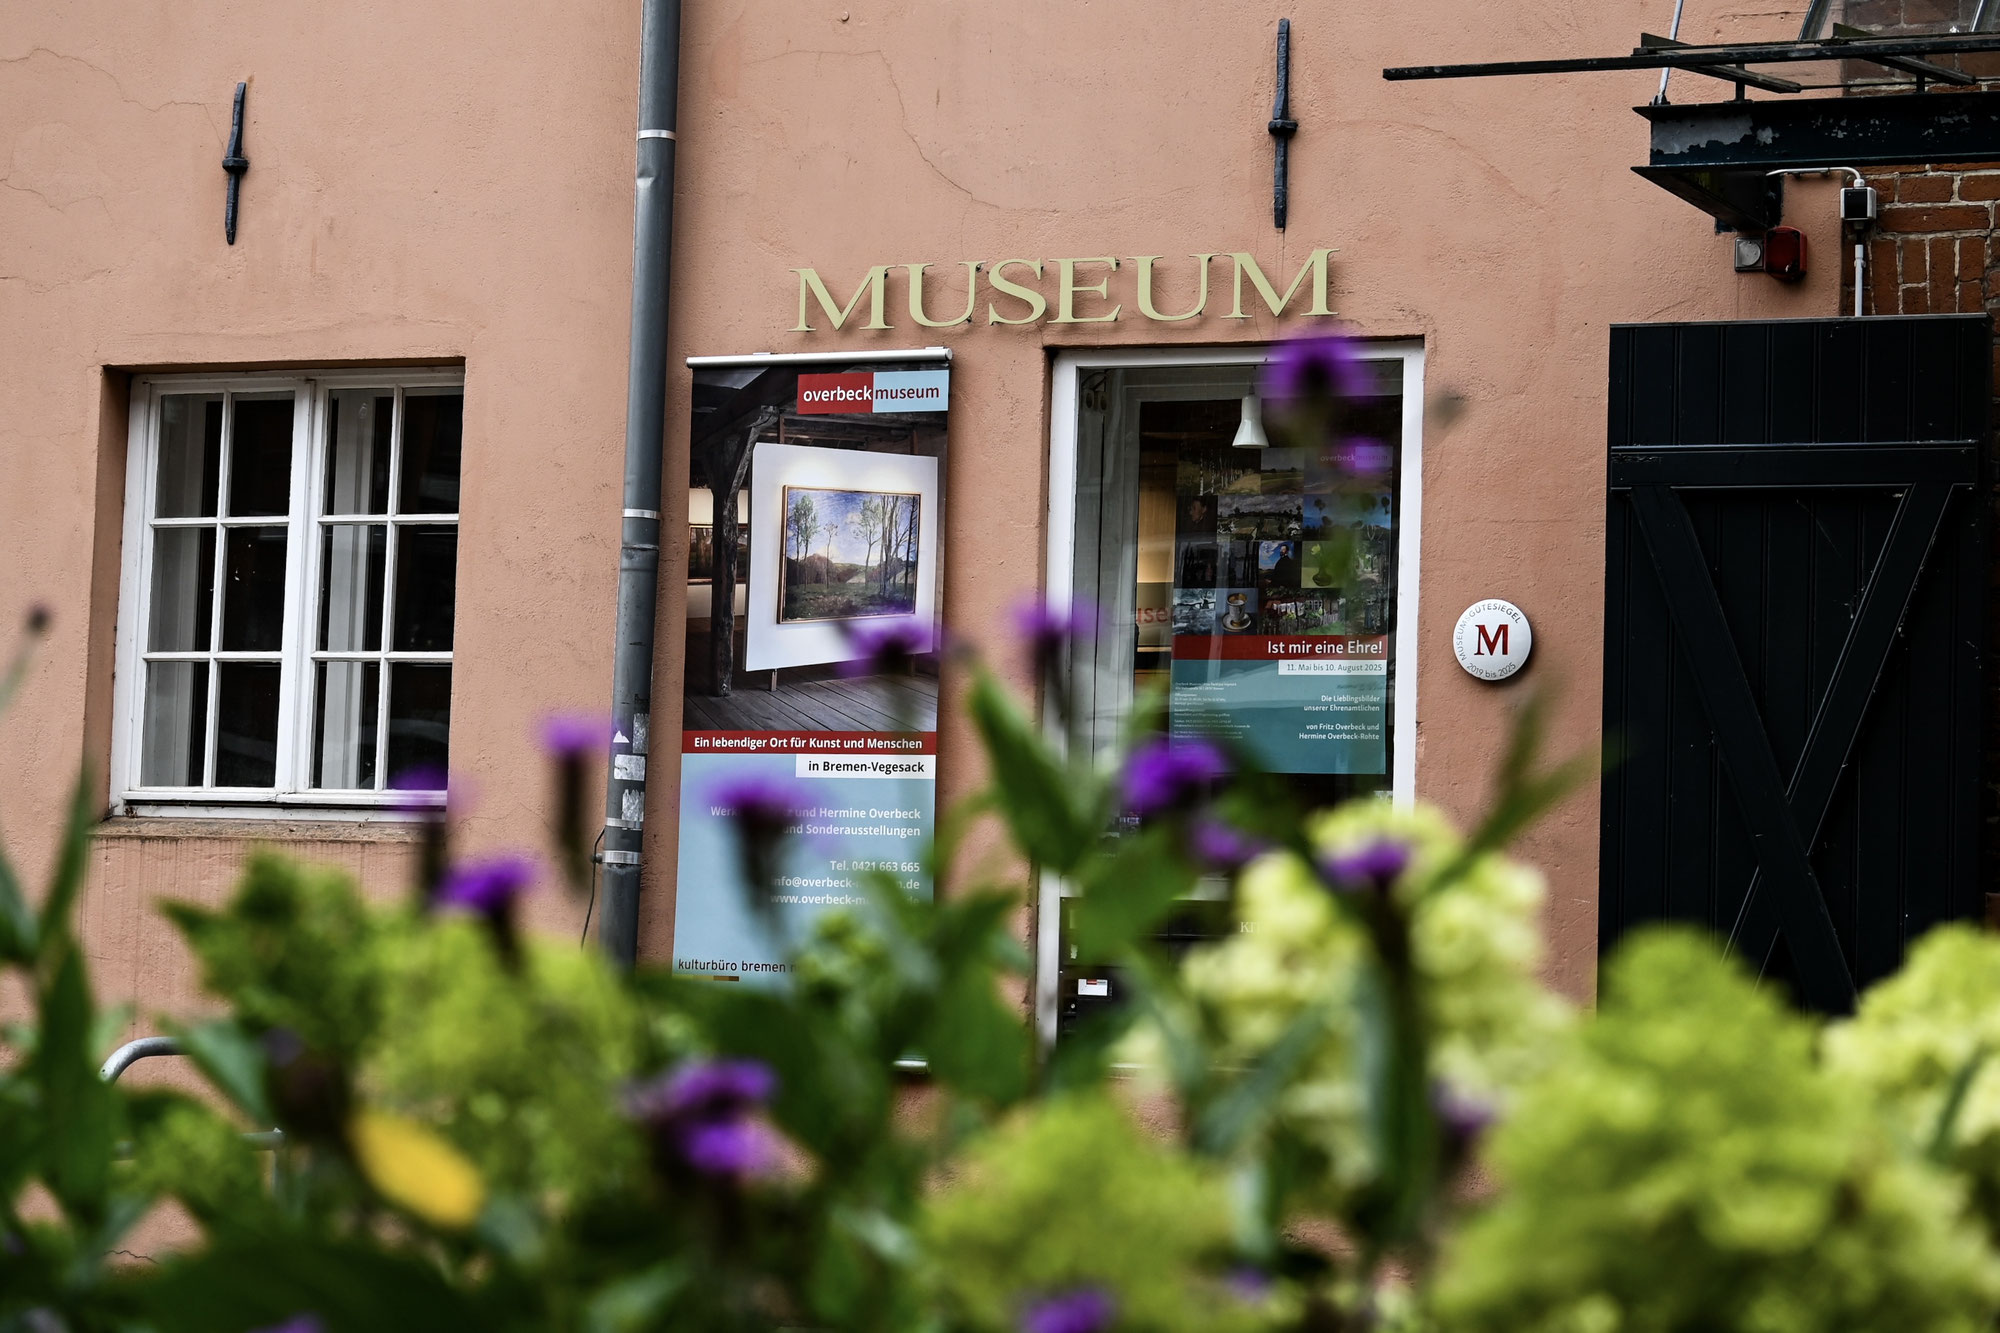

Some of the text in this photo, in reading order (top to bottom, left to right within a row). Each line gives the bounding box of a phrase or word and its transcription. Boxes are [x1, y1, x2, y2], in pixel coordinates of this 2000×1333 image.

[787, 248, 1340, 333] MUSEUM
[1473, 624, 1509, 656] M
[1268, 640, 1382, 654] Ist mir eine Ehre!
[1287, 663, 1383, 673] 11. Mai bis 10. August 2025
[1466, 662, 1484, 676] 2019
[1498, 661, 1516, 677] 2025
[1333, 695, 1380, 704] Lieblingsbilder
[1329, 704, 1380, 712] Ehrenamtlichen
[1327, 732, 1380, 740] Overbeck-Rohte
[694, 737, 923, 750] Ein lebendiger Ort für Kunst und Menschen
[808, 761, 925, 775] in Bremen-Vegesack
[710, 806, 743, 817] Werk
[794, 807, 816, 818] und
[819, 807, 866, 819] Hermine
[869, 808, 921, 819] Overbeck
[806, 824, 921, 839] Sonderausstellungen
[830, 860, 920, 873] Tel. 0421 663 665
[678, 959, 738, 972] kulturbüro
[741, 960, 786, 973] bremen
